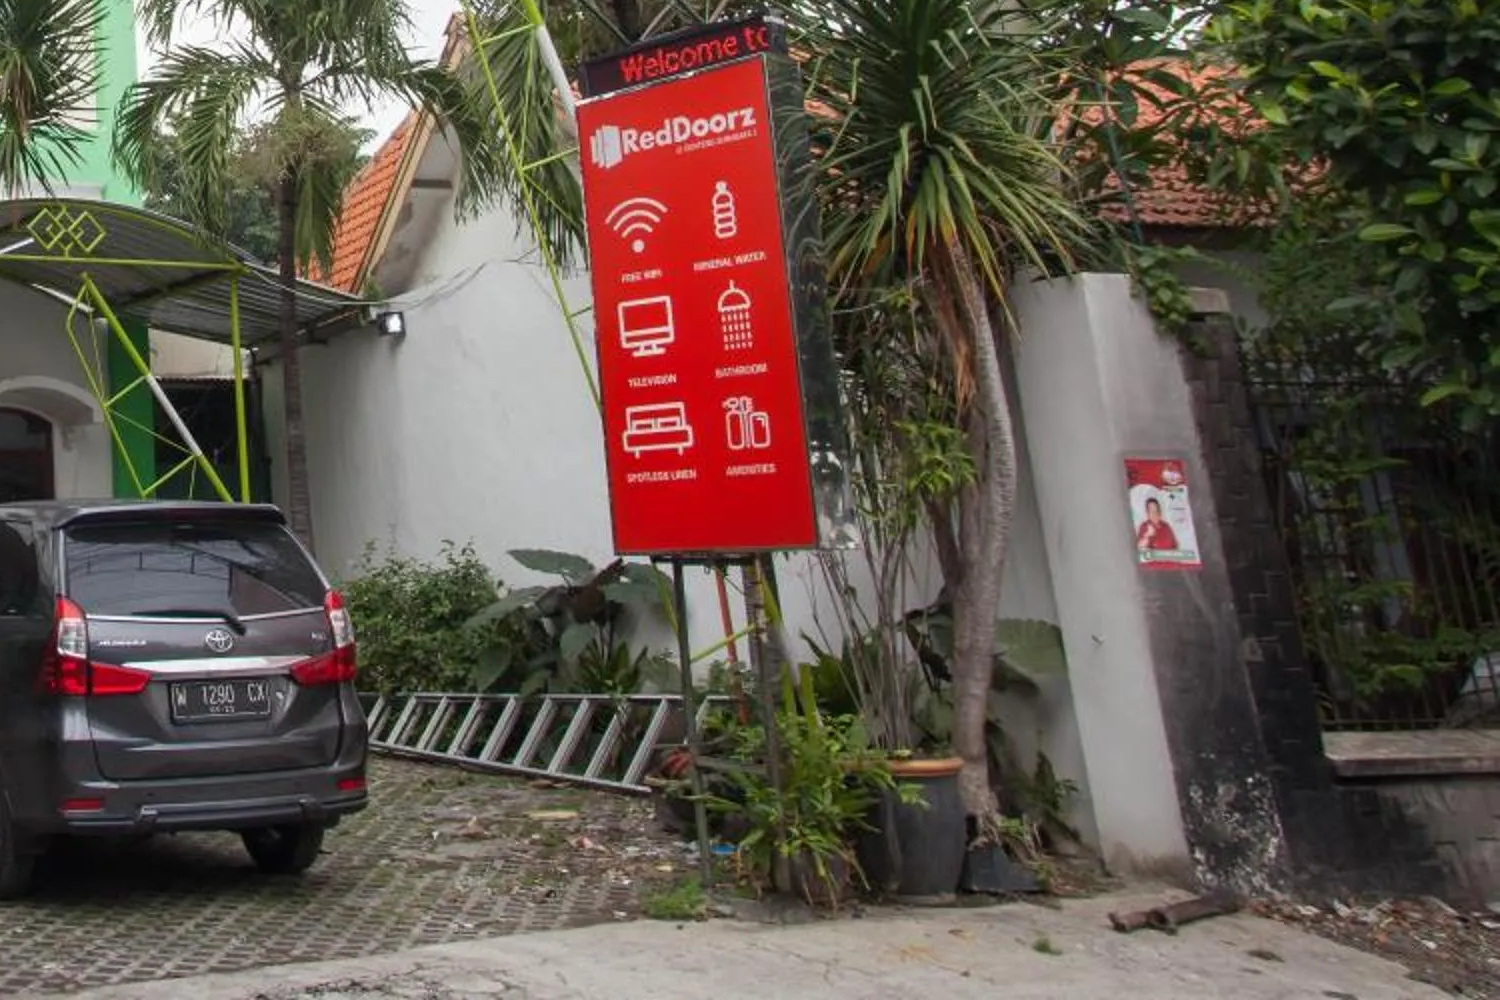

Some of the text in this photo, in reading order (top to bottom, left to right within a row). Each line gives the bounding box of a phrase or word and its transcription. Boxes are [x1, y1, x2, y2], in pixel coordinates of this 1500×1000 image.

[620, 34, 738, 83] Welcome
[622, 106, 757, 156] RedDoorz
[175, 686, 187, 706] W
[247, 682, 265, 701] CX
